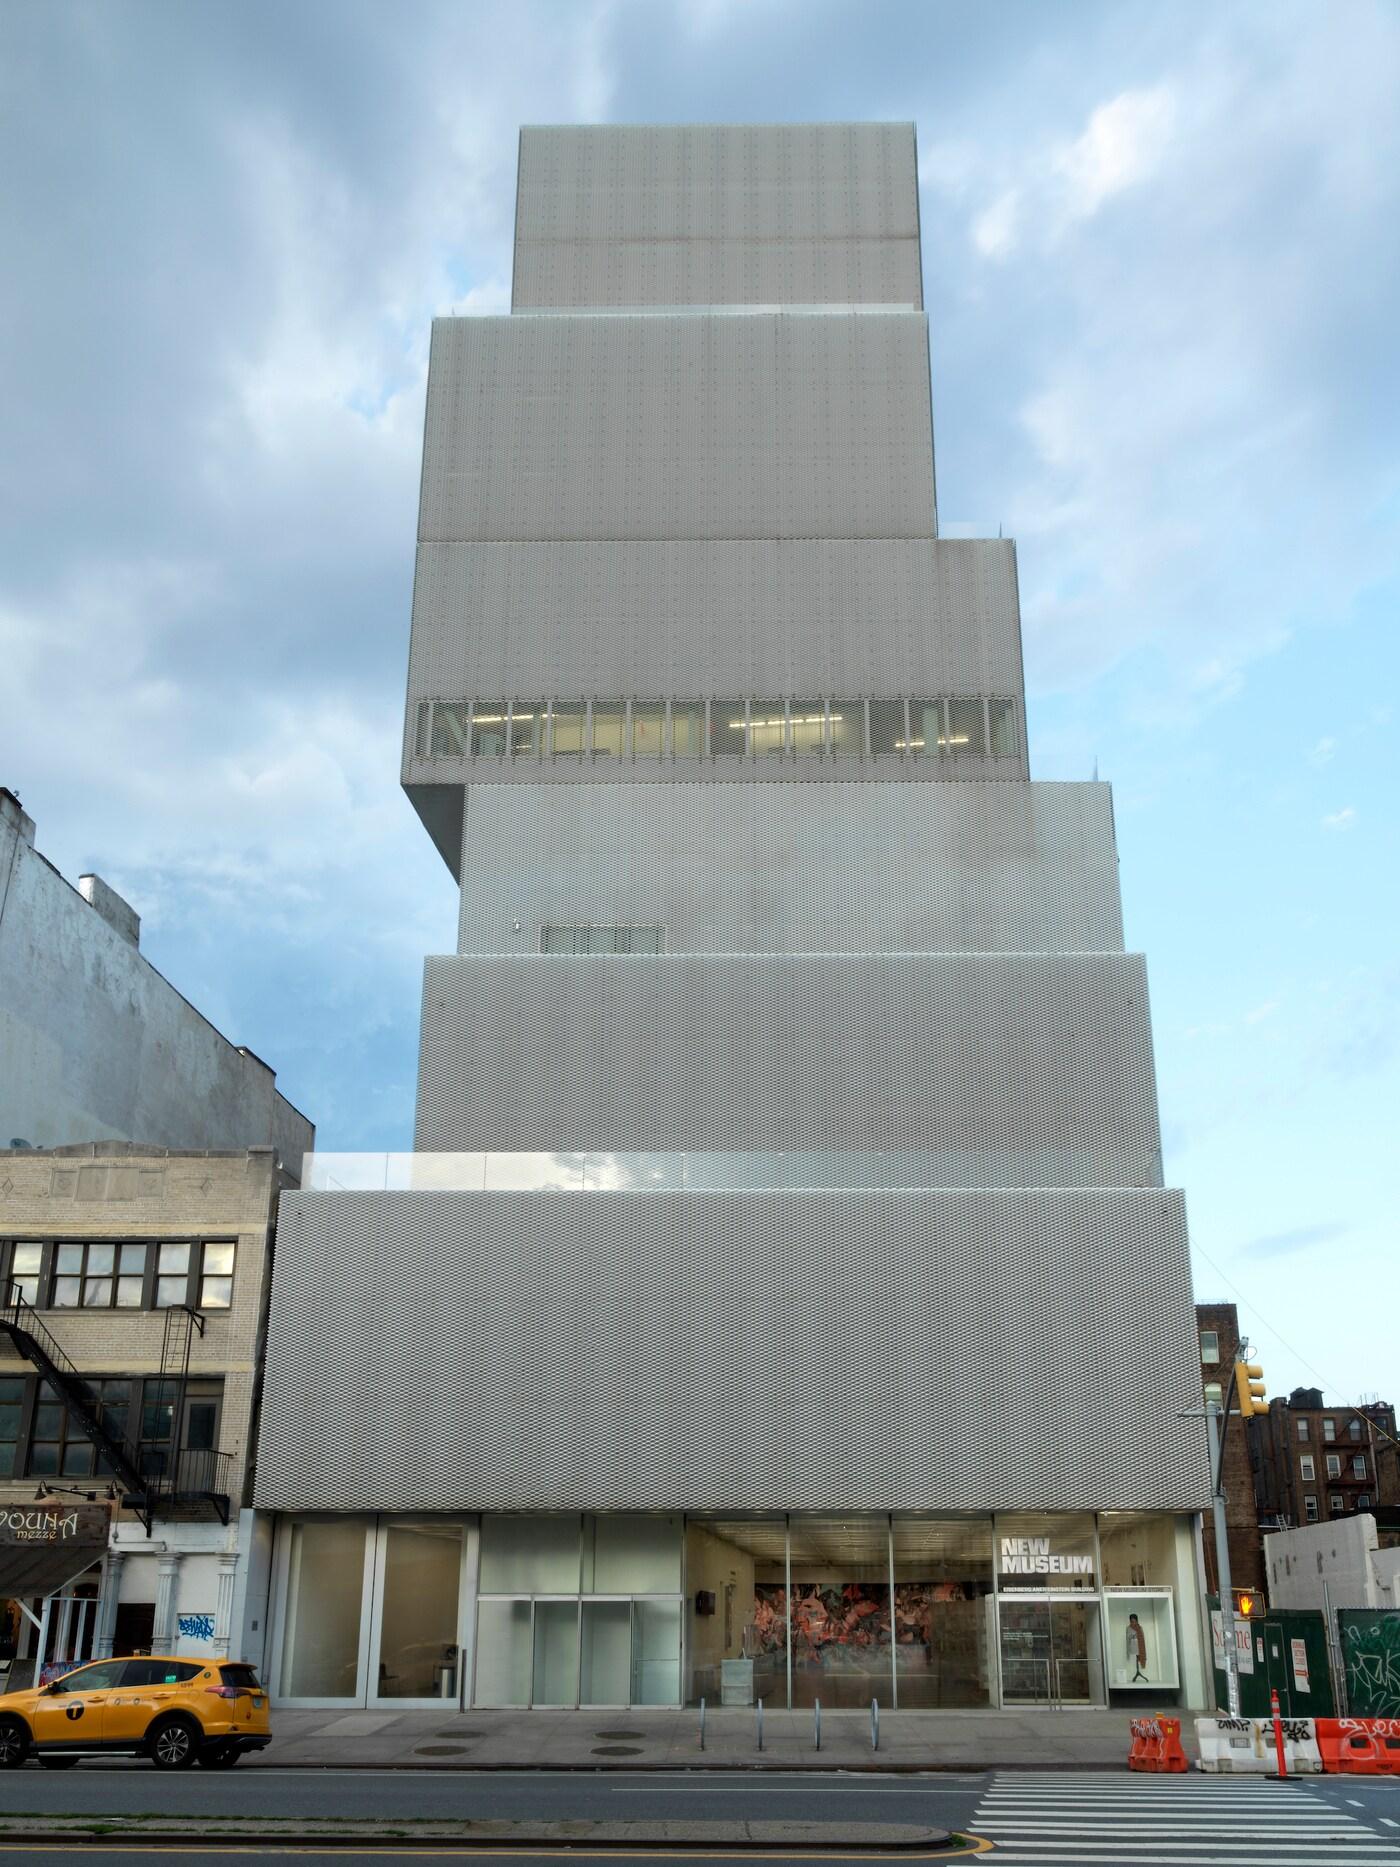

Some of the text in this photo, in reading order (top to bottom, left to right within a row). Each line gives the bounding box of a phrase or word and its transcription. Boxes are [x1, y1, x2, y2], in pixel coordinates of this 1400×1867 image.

[16, 1530, 57, 1540] mezze
[1001, 1537, 1050, 1556] NEW
[1002, 1555, 1093, 1574] MUSEUM
